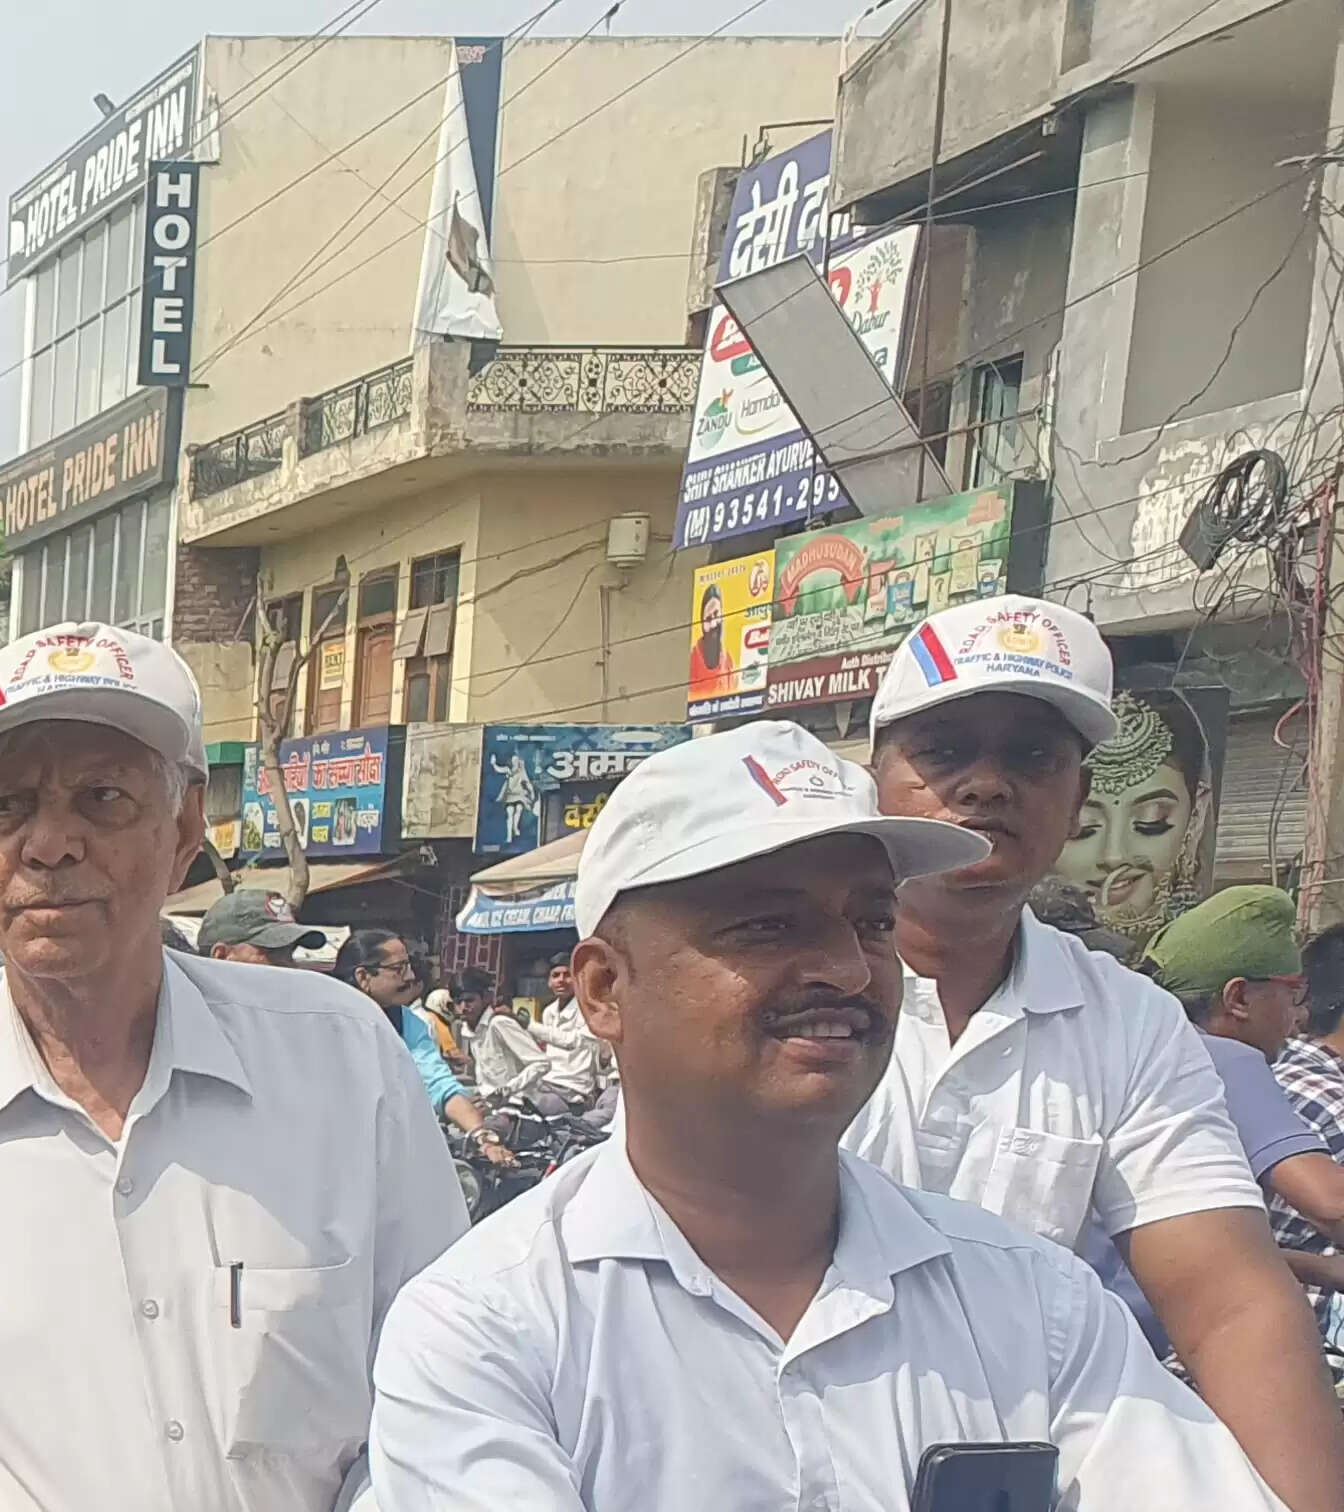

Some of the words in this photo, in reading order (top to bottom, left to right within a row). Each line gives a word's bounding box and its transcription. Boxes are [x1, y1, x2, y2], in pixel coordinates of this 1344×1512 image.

[25, 169, 77, 258] HOTEL
[80, 118, 142, 214] PRIDE
[145, 85, 187, 166] INN
[151, 172, 192, 374] HOTEL
[696, 411, 733, 437] ZANDU
[4, 466, 58, 537] HOTEL
[61, 432, 118, 511] PRIDE
[122, 408, 162, 482] INN
[95, 638, 135, 681] OFFICER
[767, 679, 825, 705] SHIVAY
[828, 668, 872, 695] MILK
